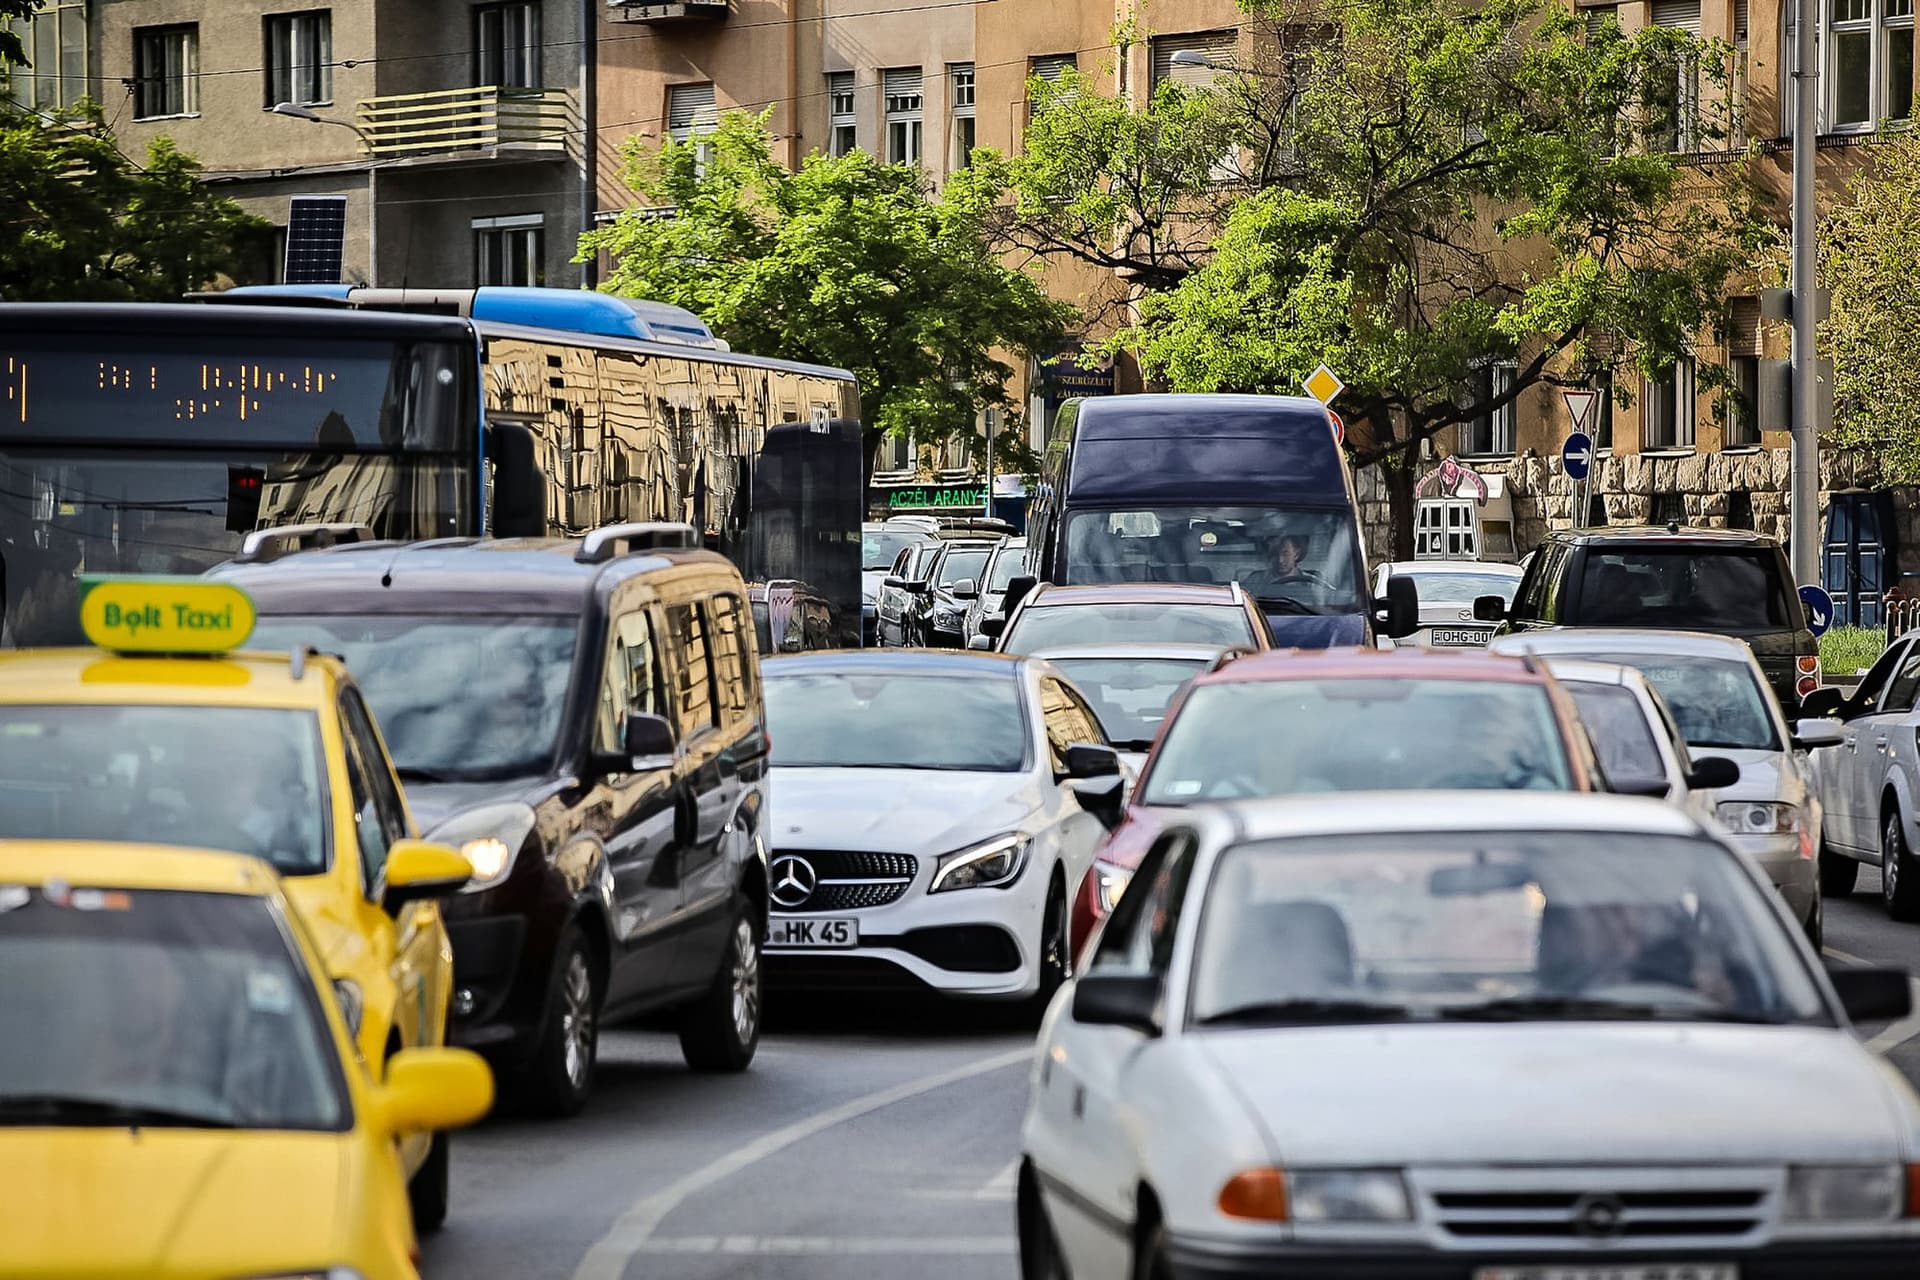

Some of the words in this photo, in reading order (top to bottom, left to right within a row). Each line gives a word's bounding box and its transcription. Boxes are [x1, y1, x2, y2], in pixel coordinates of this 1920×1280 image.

[889, 487, 930, 507] ACZÉL
[934, 489, 979, 506] ARANY
[104, 603, 160, 637] Bolt
[174, 603, 232, 628] Taxi
[1443, 631, 1494, 643] OHG-00
[785, 921, 815, 943] HK
[820, 921, 848, 943] 45
